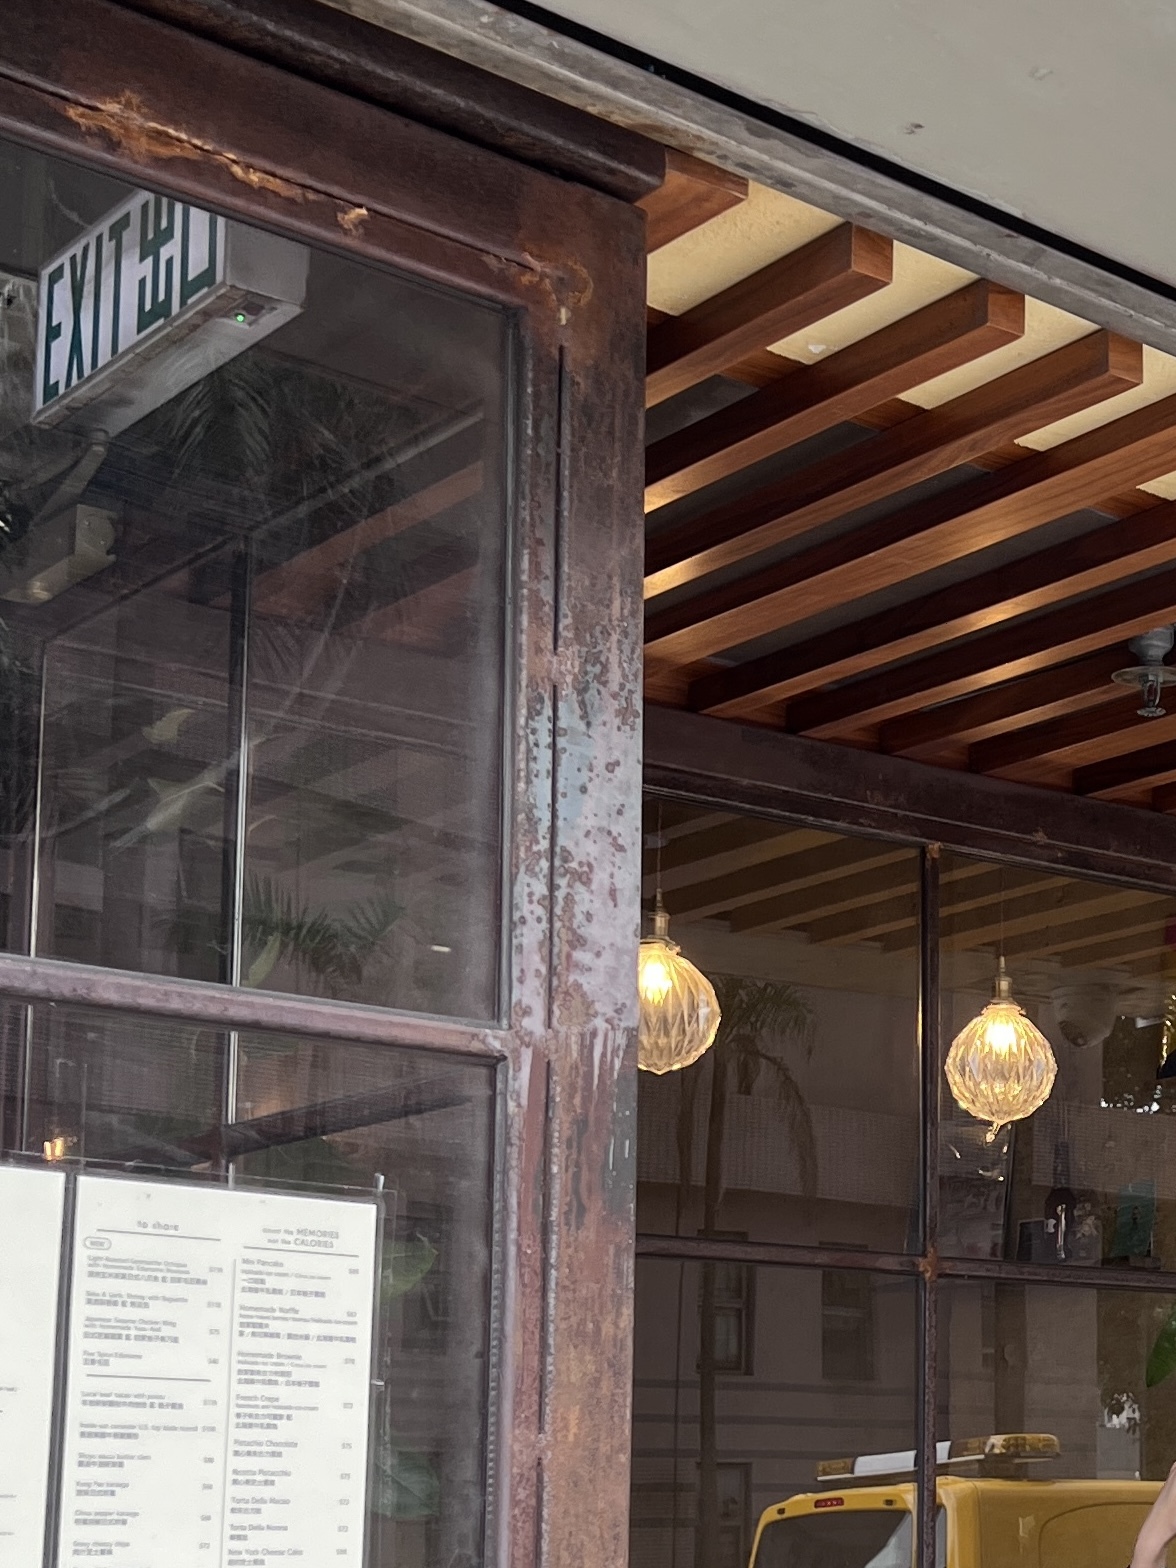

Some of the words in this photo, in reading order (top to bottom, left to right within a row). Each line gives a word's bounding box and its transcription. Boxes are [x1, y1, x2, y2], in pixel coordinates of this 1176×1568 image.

[43, 211, 131, 406] EXIT
[137, 196, 218, 336] 出口
[296, 1228, 340, 1239] MEMORIES
[294, 1238, 333, 1249] CALORIES
